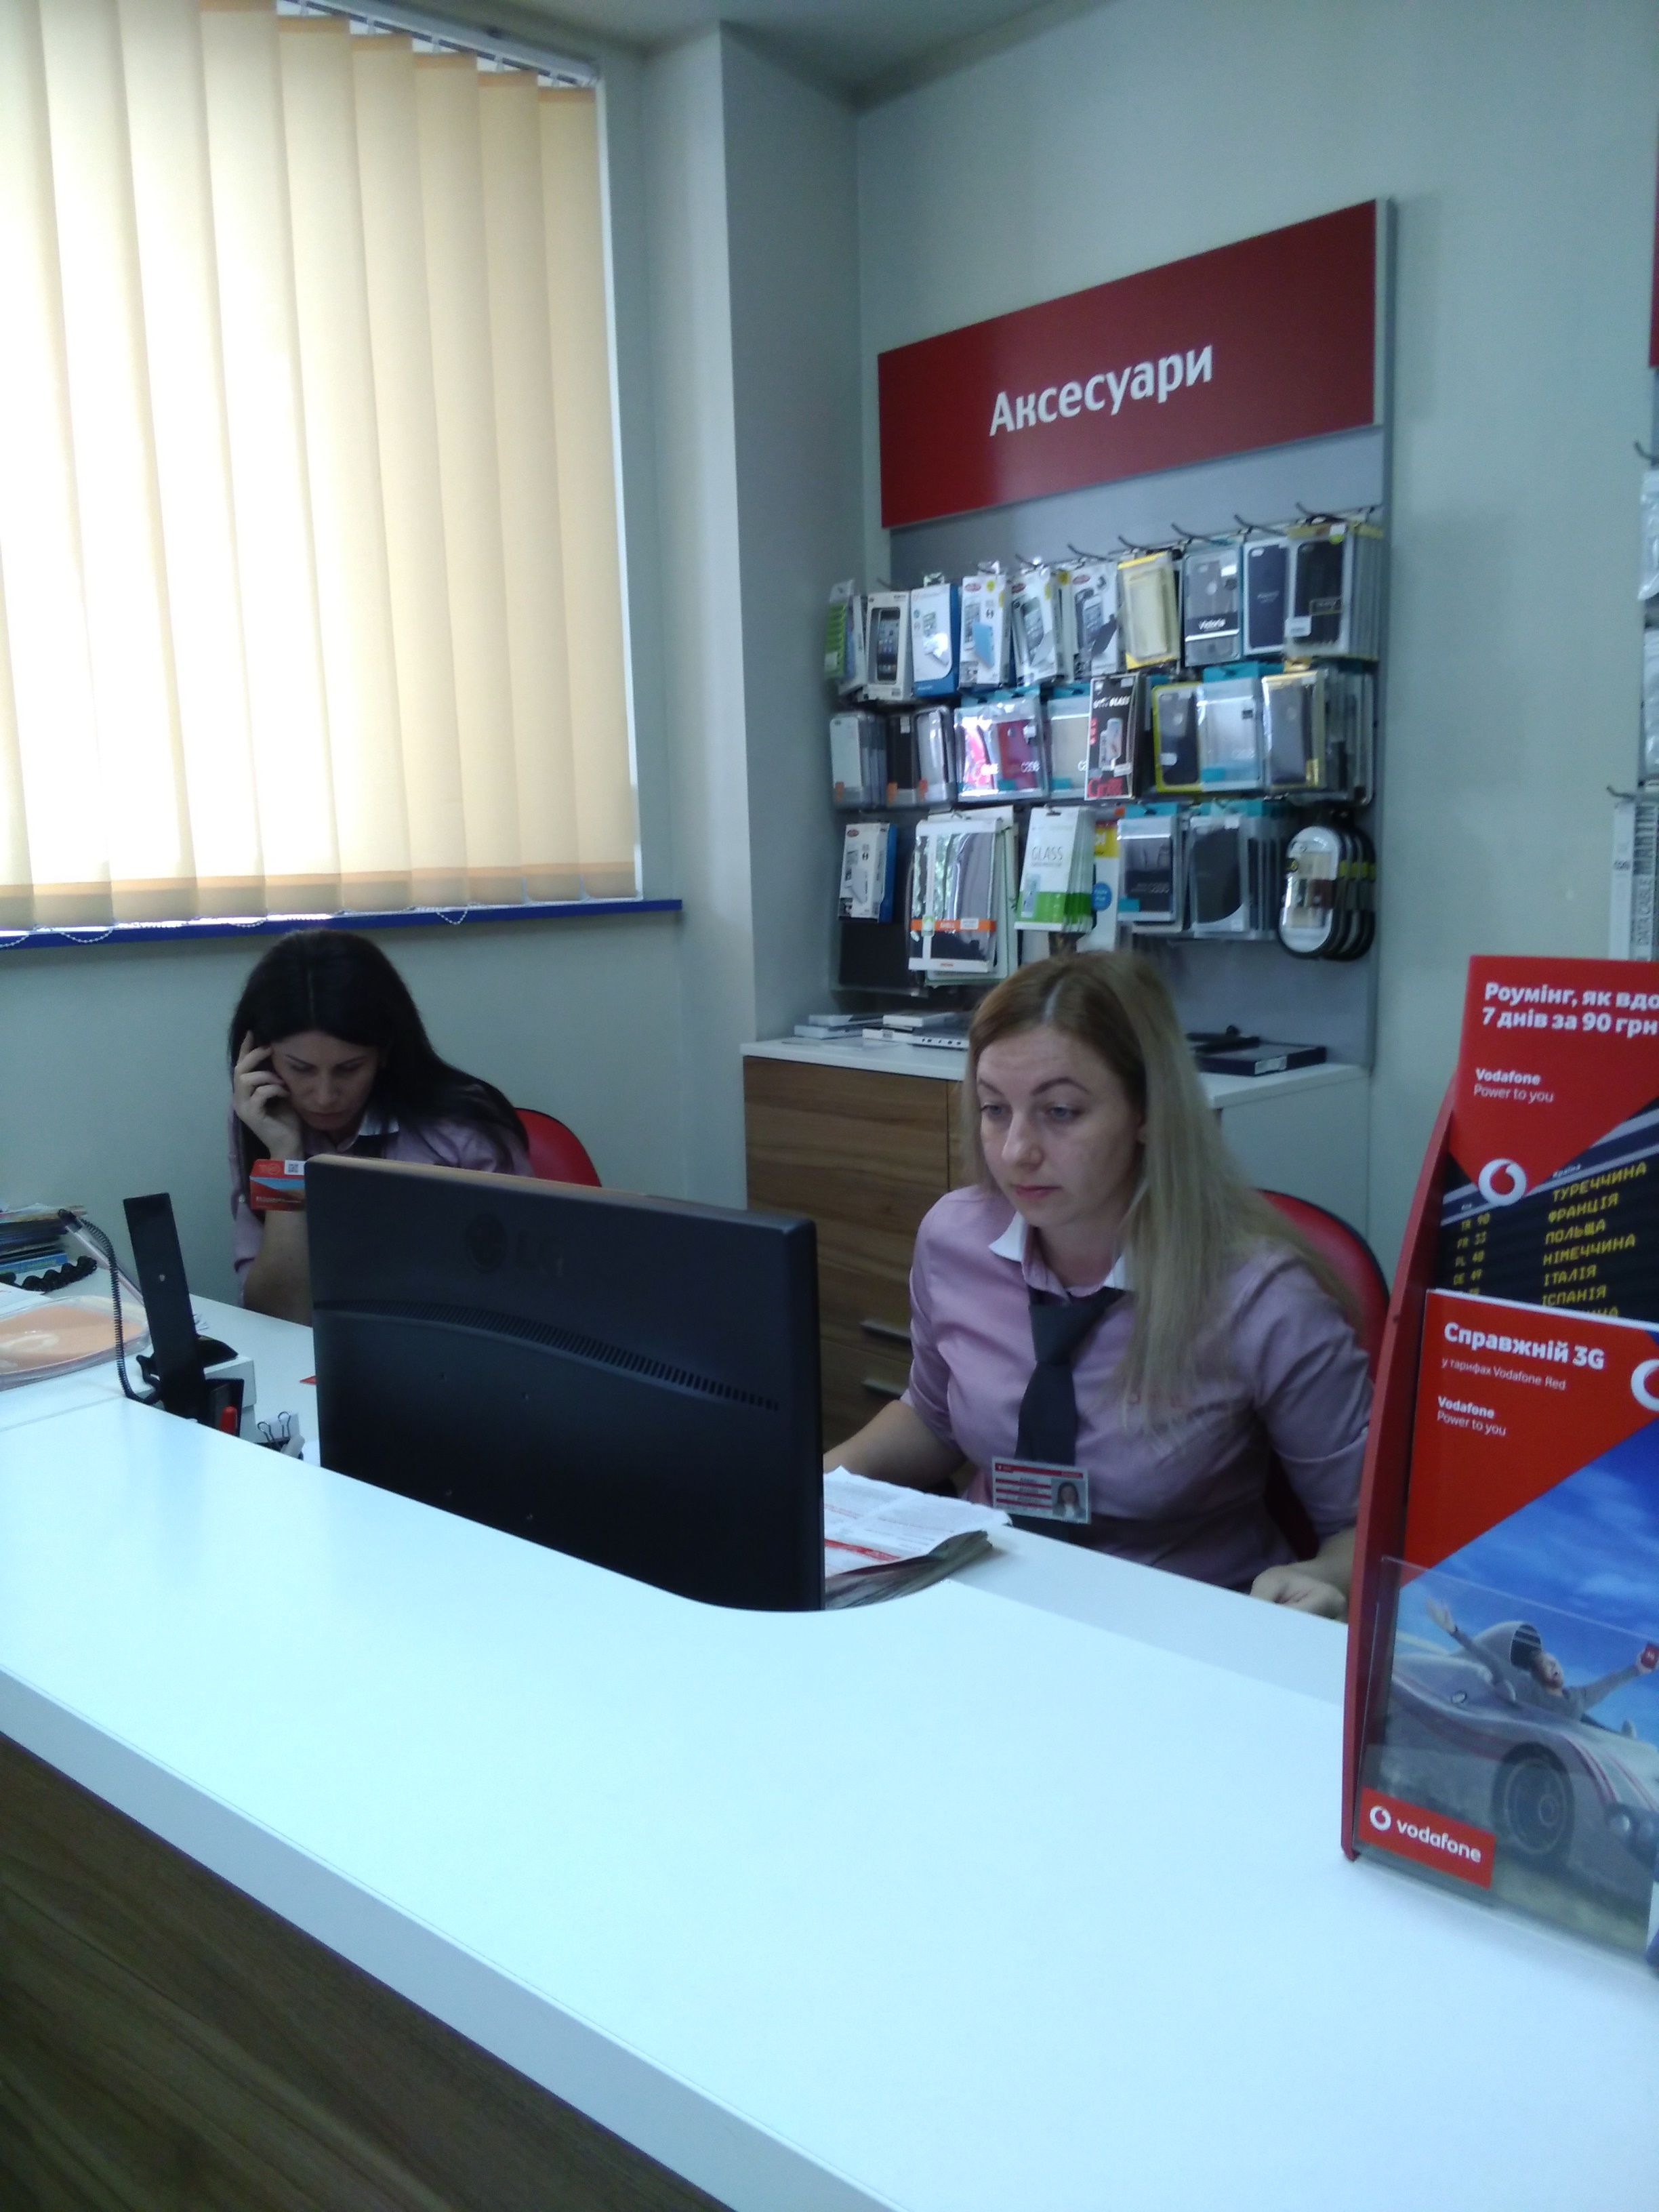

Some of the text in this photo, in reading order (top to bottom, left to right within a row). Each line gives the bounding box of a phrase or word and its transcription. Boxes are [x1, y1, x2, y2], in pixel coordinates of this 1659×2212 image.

[989, 344, 1213, 437] Аксесуари
[1031, 846, 1063, 861] GLASS
[1484, 982, 1578, 1007] Роумінг,
[1582, 990, 1612, 1006] як
[1482, 1006, 1658, 1038] 7 днів за 90 грн
[1475, 1067, 1541, 1085] Vodafone
[1473, 1083, 1554, 1104] Power to you
[1552, 1162, 1647, 1203] ТУРЕЧЧИНА
[1548, 1192, 1620, 1224] ФРАНЦІЯ
[1545, 1219, 1606, 1246] ПОЛЬЩА
[1542, 1233, 1636, 1266] НІМЕЧЧИНА
[1544, 1265, 1597, 1287] ІТАЛІЯ
[1443, 1322, 1605, 1370] Справжній 3G
[1450, 1357, 1492, 1376] тарифах
[1493, 1366, 1542, 1386] Vodafone
[1544, 1376, 1567, 1391] Red
[1437, 1395, 1495, 1419] Vodafone
[1436, 1410, 1507, 1437] Power to you
[1396, 1818, 1482, 1864] vodafone
